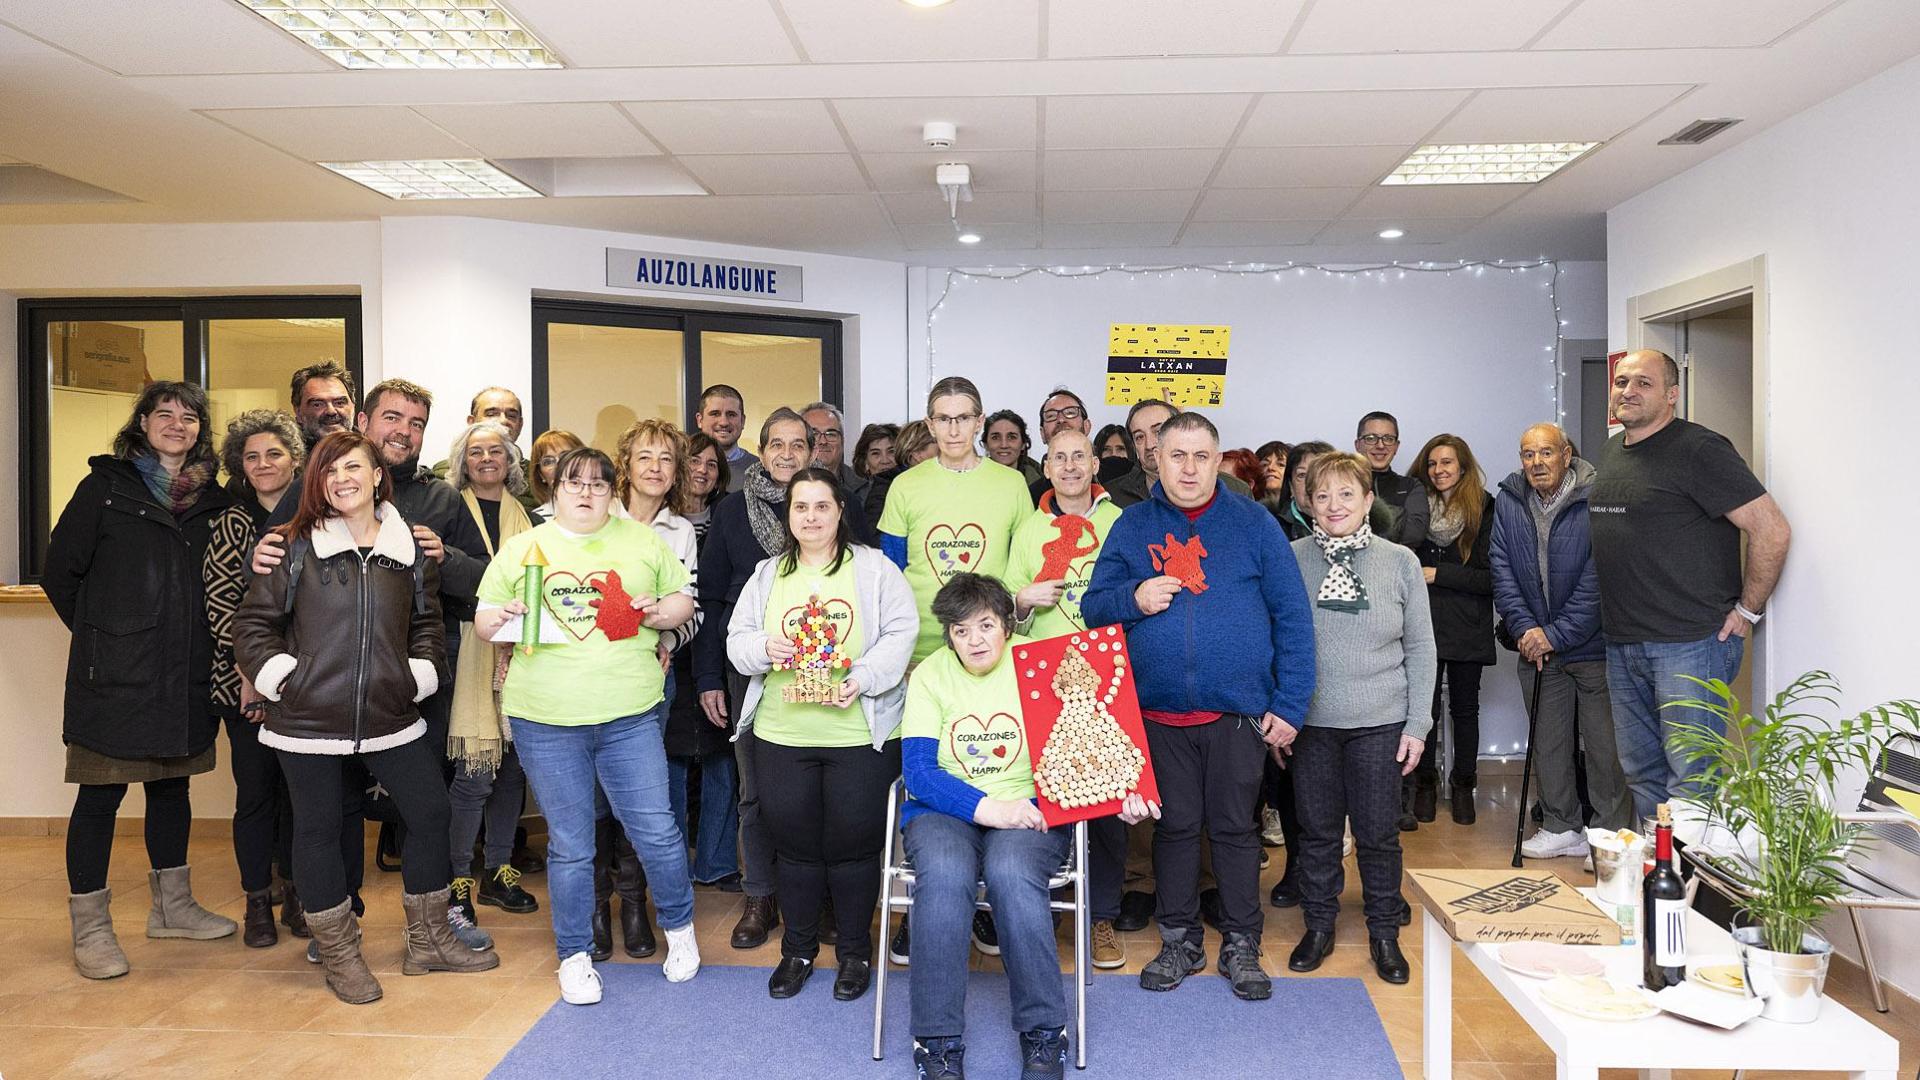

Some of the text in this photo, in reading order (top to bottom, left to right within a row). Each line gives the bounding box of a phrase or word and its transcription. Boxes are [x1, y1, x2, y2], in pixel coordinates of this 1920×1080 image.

[637, 257, 777, 294] AUZOLANGUNE
[1141, 362, 1193, 370] LATXAN
[931, 540, 980, 548] CORAZONES
[957, 731, 1017, 742] CORAZONES
[971, 766, 1002, 774] HAPPY
[1476, 926, 1495, 938] dal
